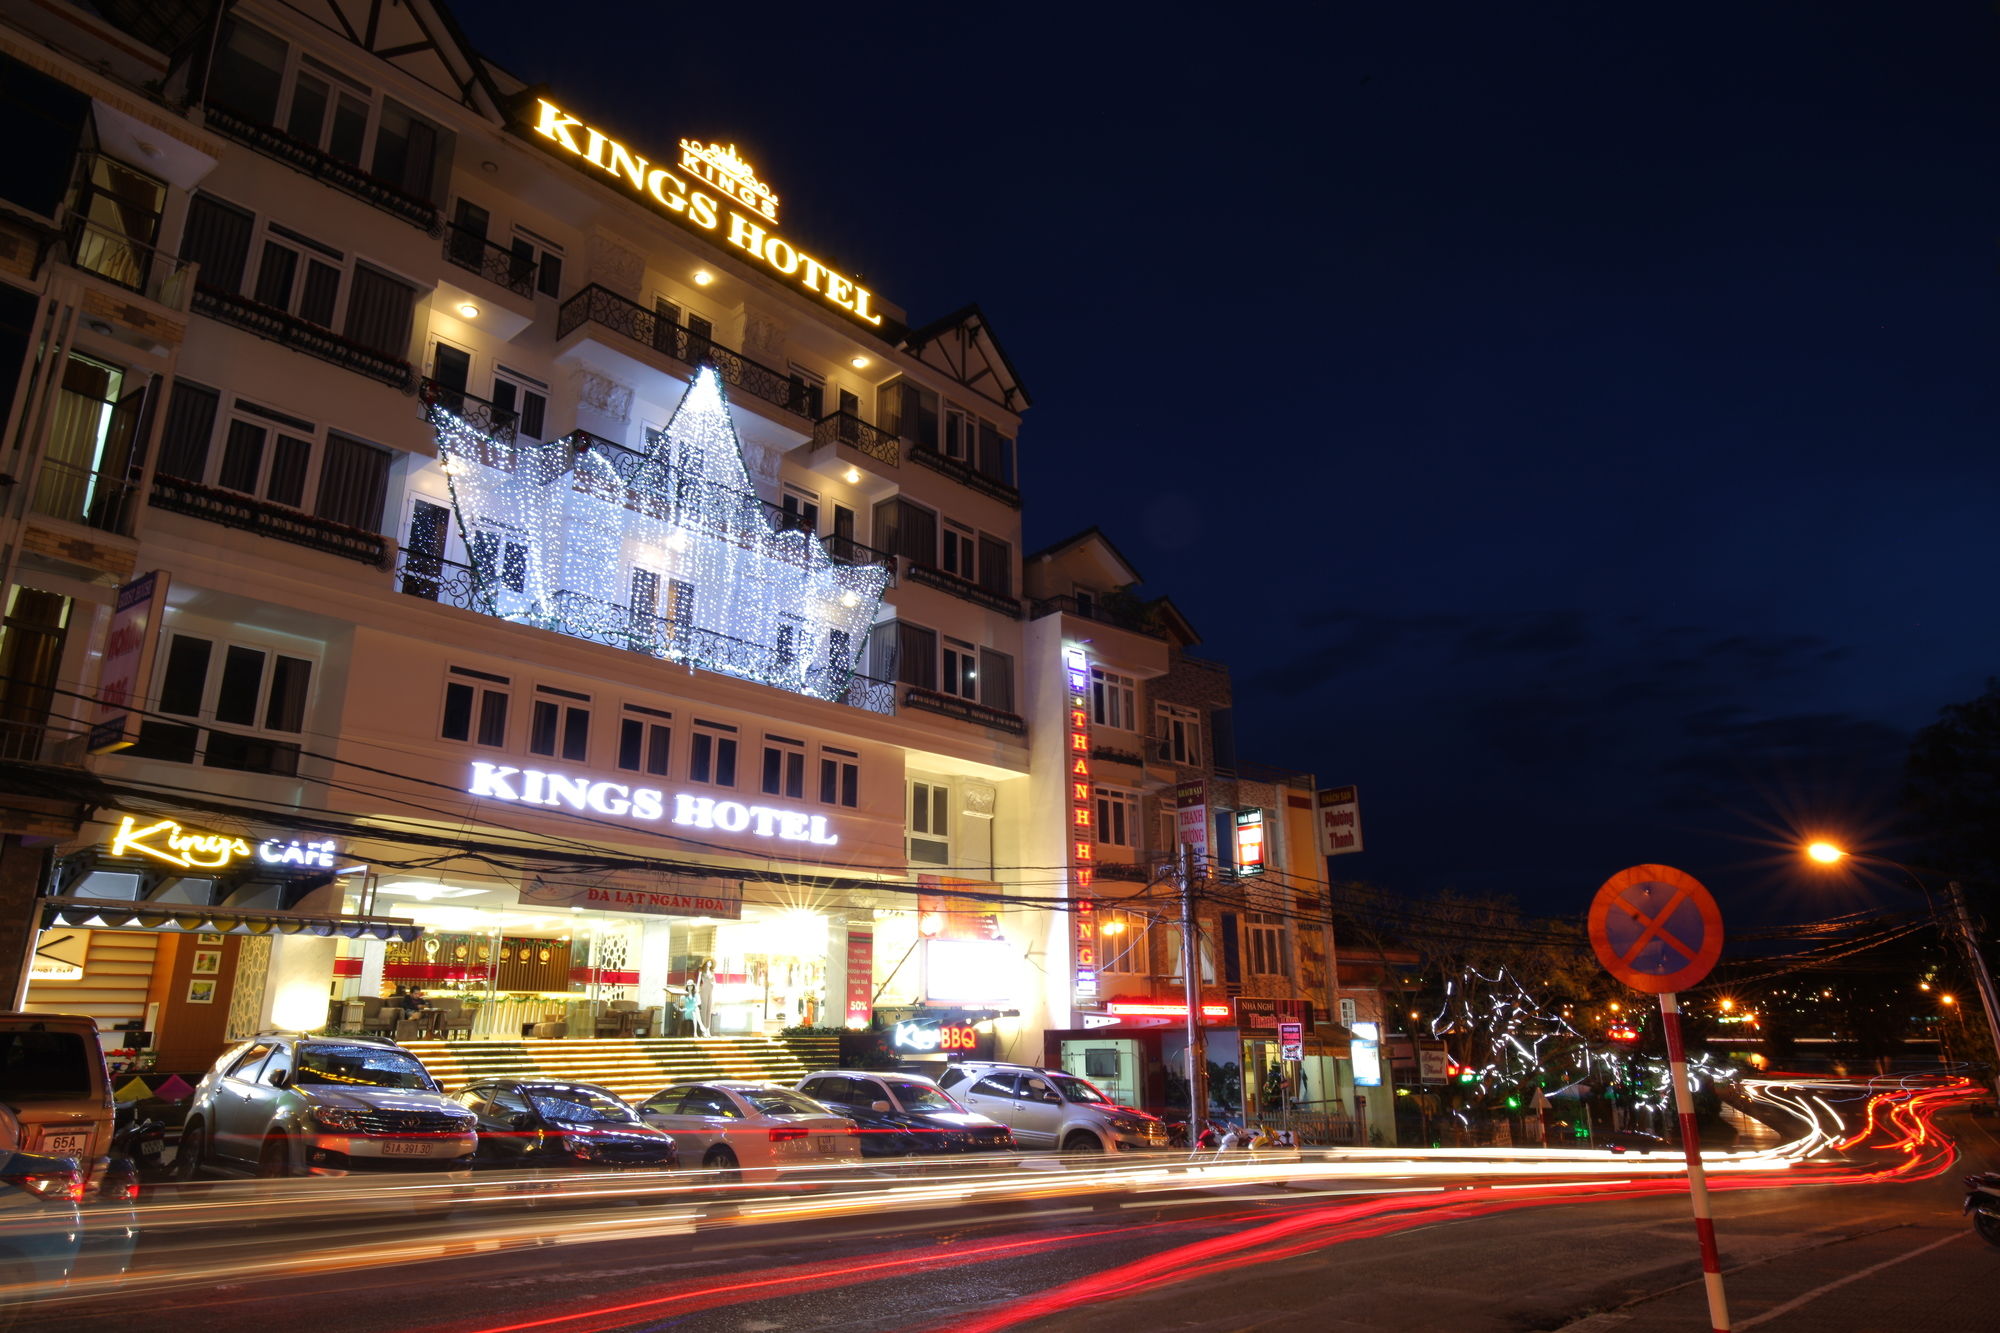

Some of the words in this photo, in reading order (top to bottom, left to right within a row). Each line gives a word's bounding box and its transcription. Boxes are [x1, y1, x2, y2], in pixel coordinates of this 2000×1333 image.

[684, 153, 776, 219] KINGS
[534, 97, 718, 231] KINGS
[727, 211, 881, 326] HOTEL
[469, 761, 663, 821] KINGS
[672, 793, 838, 846] HOTEL
[1180, 809, 1204, 826] THANH
[112, 816, 251, 868] Kings
[850, 1000, 868, 1011] 50%
[941, 1026, 976, 1049] BBQ
[53, 1136, 75, 1149] 65A
